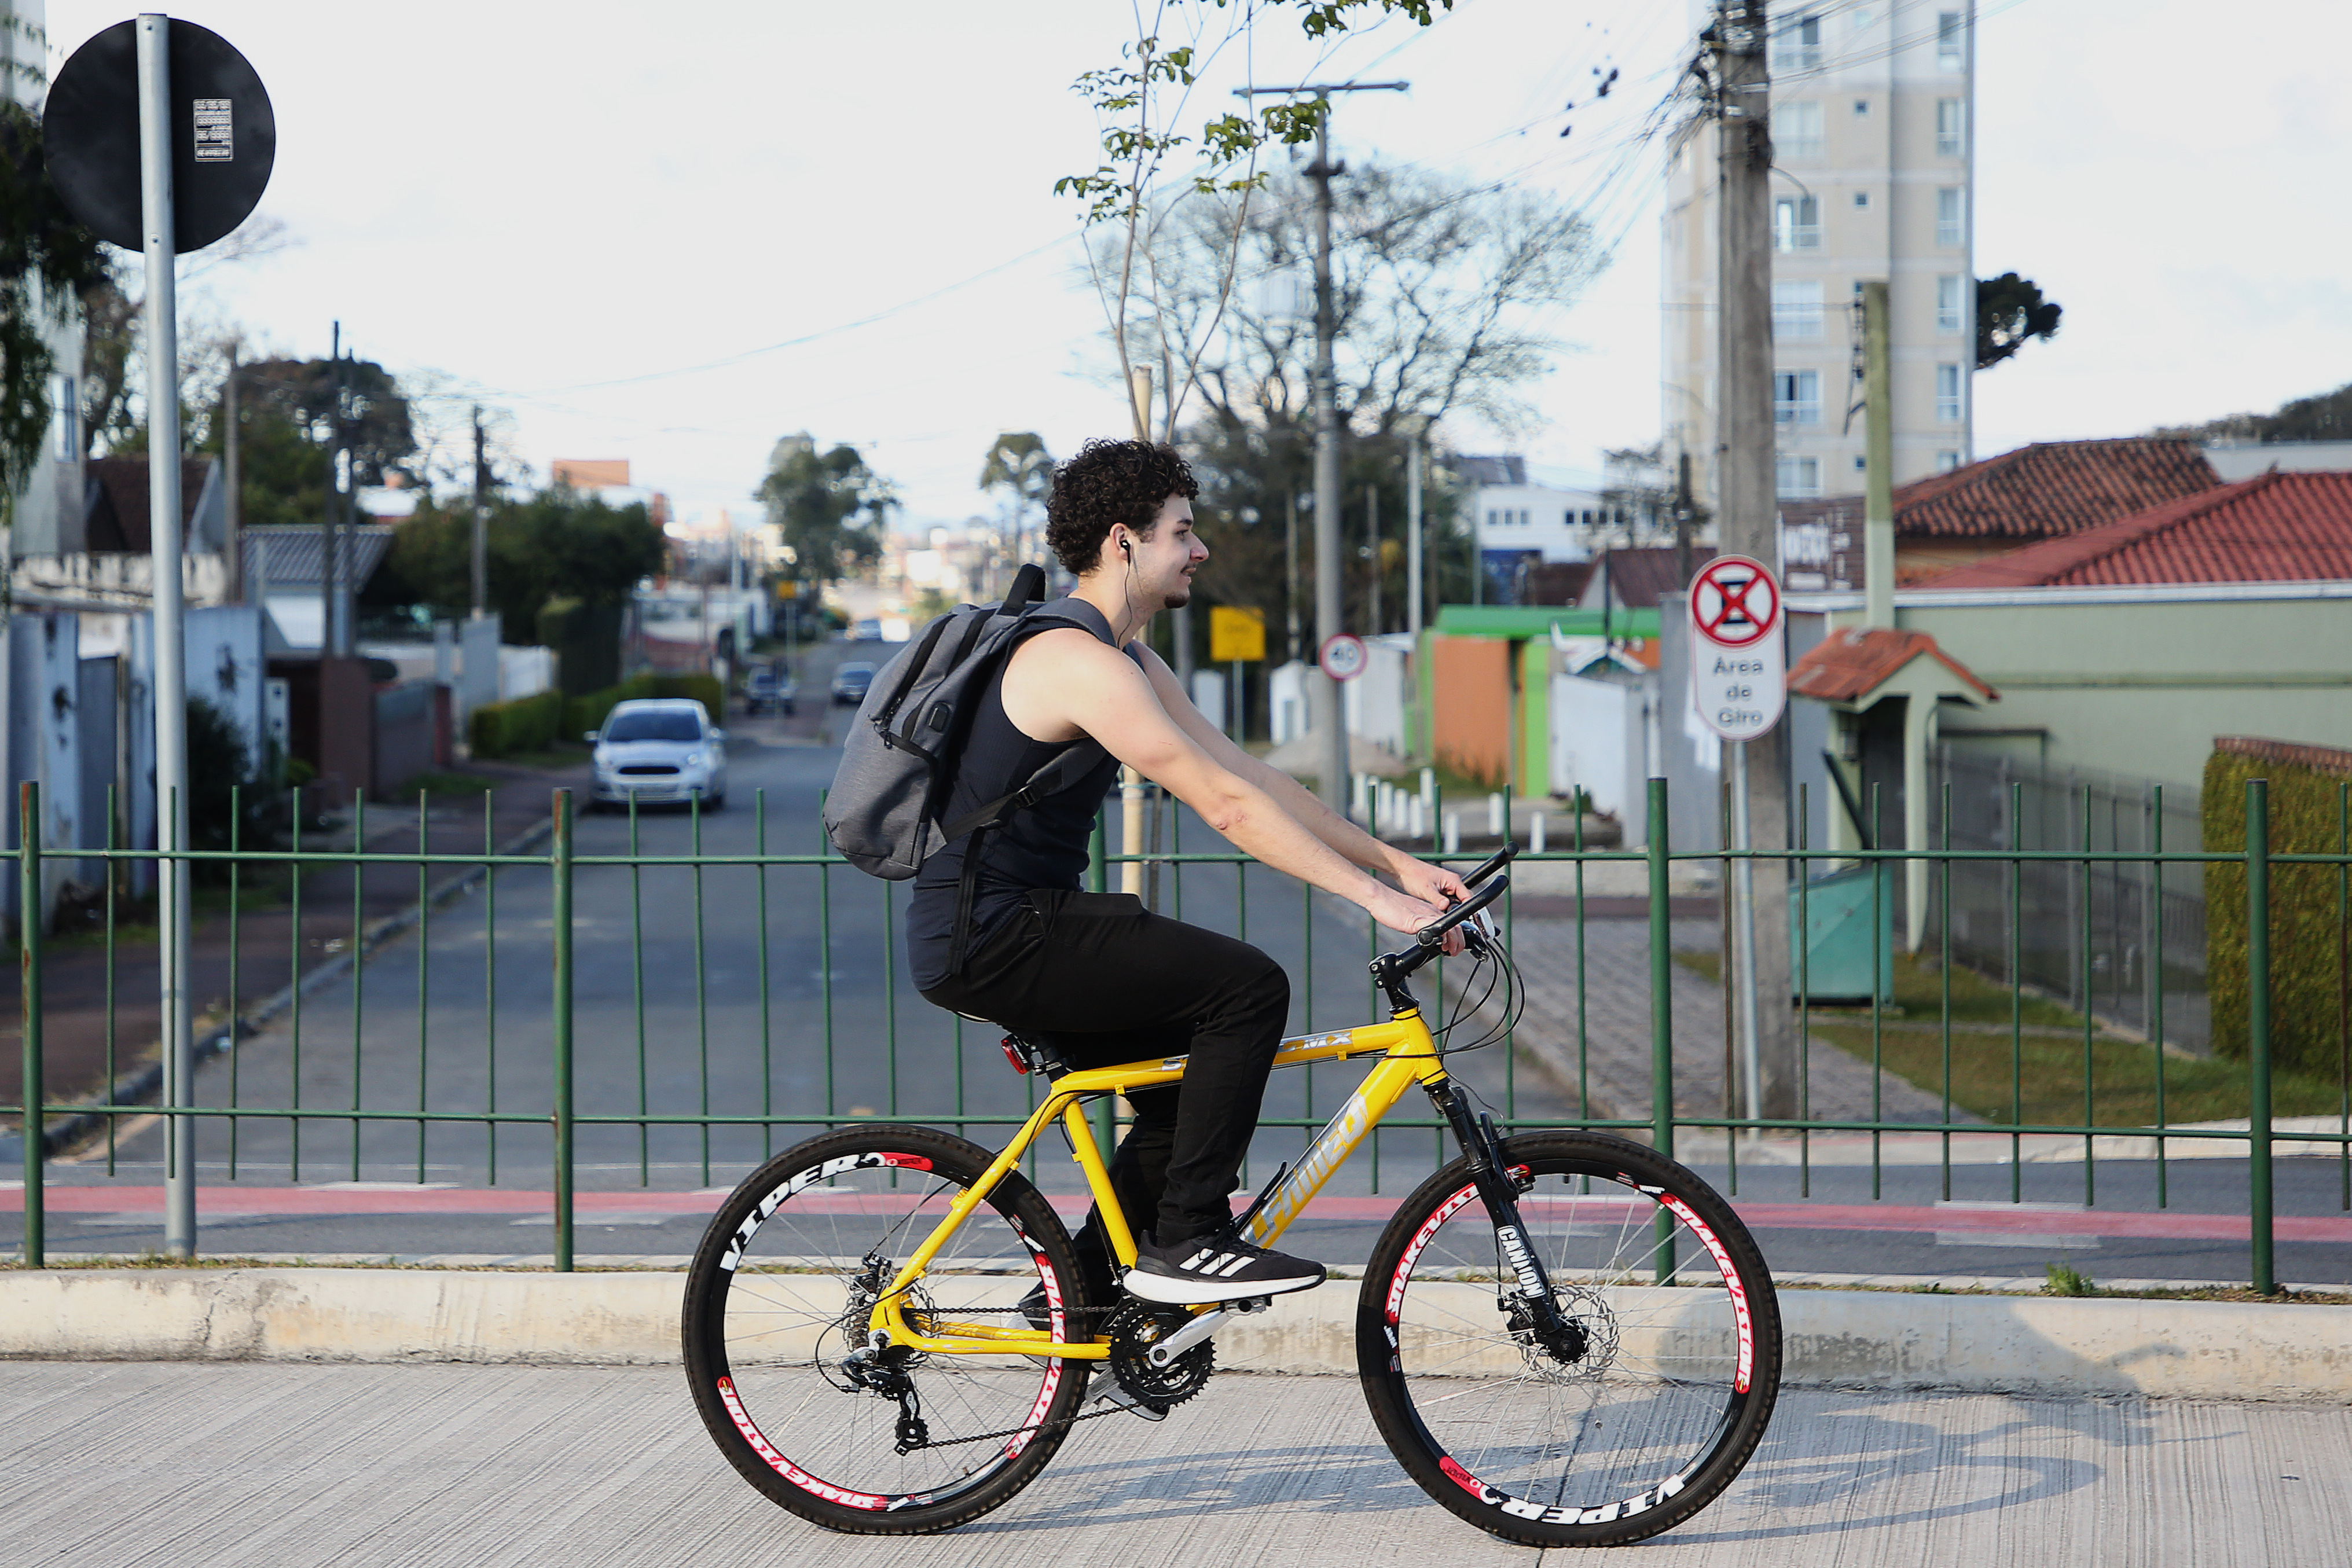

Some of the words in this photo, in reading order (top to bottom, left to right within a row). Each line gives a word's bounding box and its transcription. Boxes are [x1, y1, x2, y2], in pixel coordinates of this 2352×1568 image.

[1330, 644, 1359, 665] 40
[1726, 682, 1752, 702] de
[1718, 707, 1763, 728] Giro
[1239, 1092, 1368, 1248] LFAMEQ
[720, 1154, 861, 1272] VIPER
[1500, 1474, 1685, 1525] VIPER
